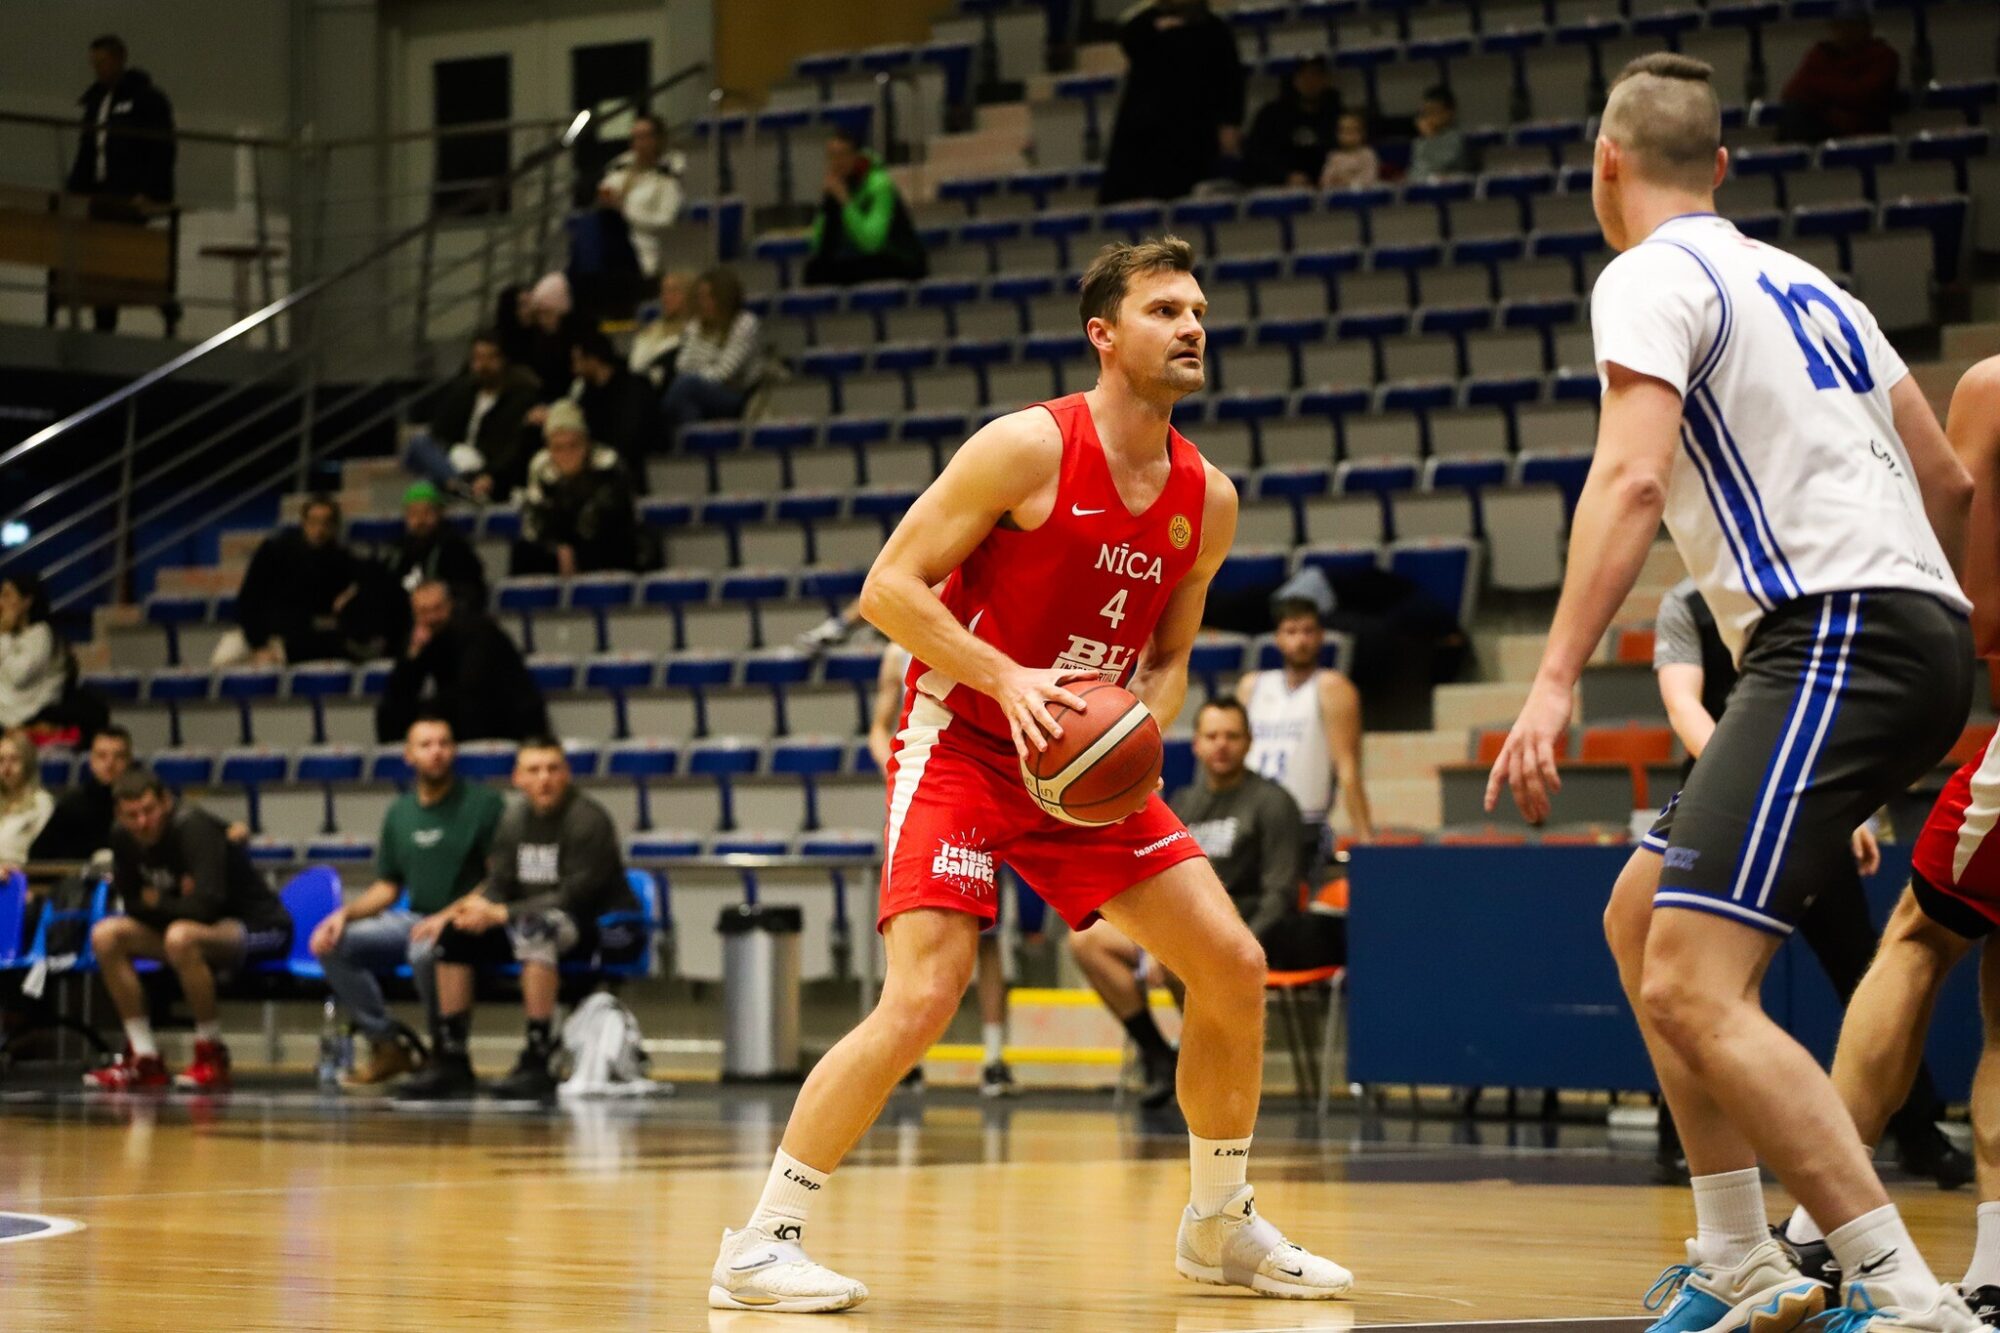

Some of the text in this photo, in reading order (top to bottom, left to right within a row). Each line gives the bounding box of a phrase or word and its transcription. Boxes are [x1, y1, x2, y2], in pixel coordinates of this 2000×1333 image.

[1757, 271, 1875, 394] 10
[1094, 543, 1162, 584] NĪCA
[1099, 589, 1128, 629] 4
